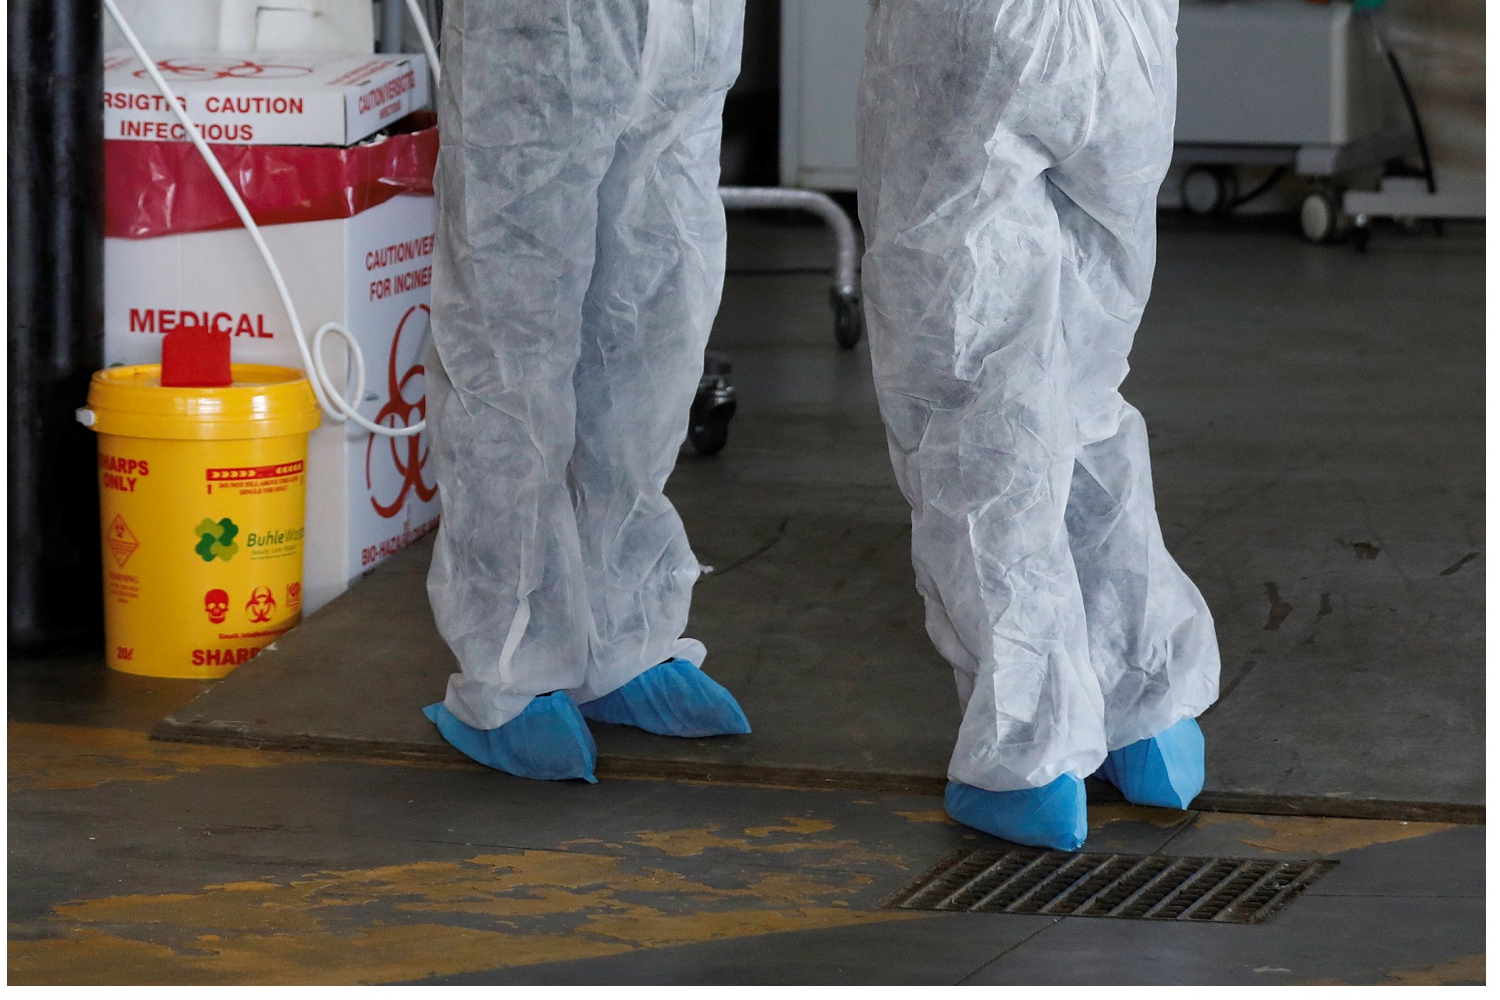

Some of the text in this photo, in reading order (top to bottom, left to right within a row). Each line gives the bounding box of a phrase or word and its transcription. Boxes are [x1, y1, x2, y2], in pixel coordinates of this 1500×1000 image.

[205, 96, 304, 114] CAUTION
[120, 120, 254, 141] INFECIOUS
[369, 277, 392, 302] FOR
[129, 308, 274, 339] MEDICAL
[192, 647, 262, 666] SHARP
